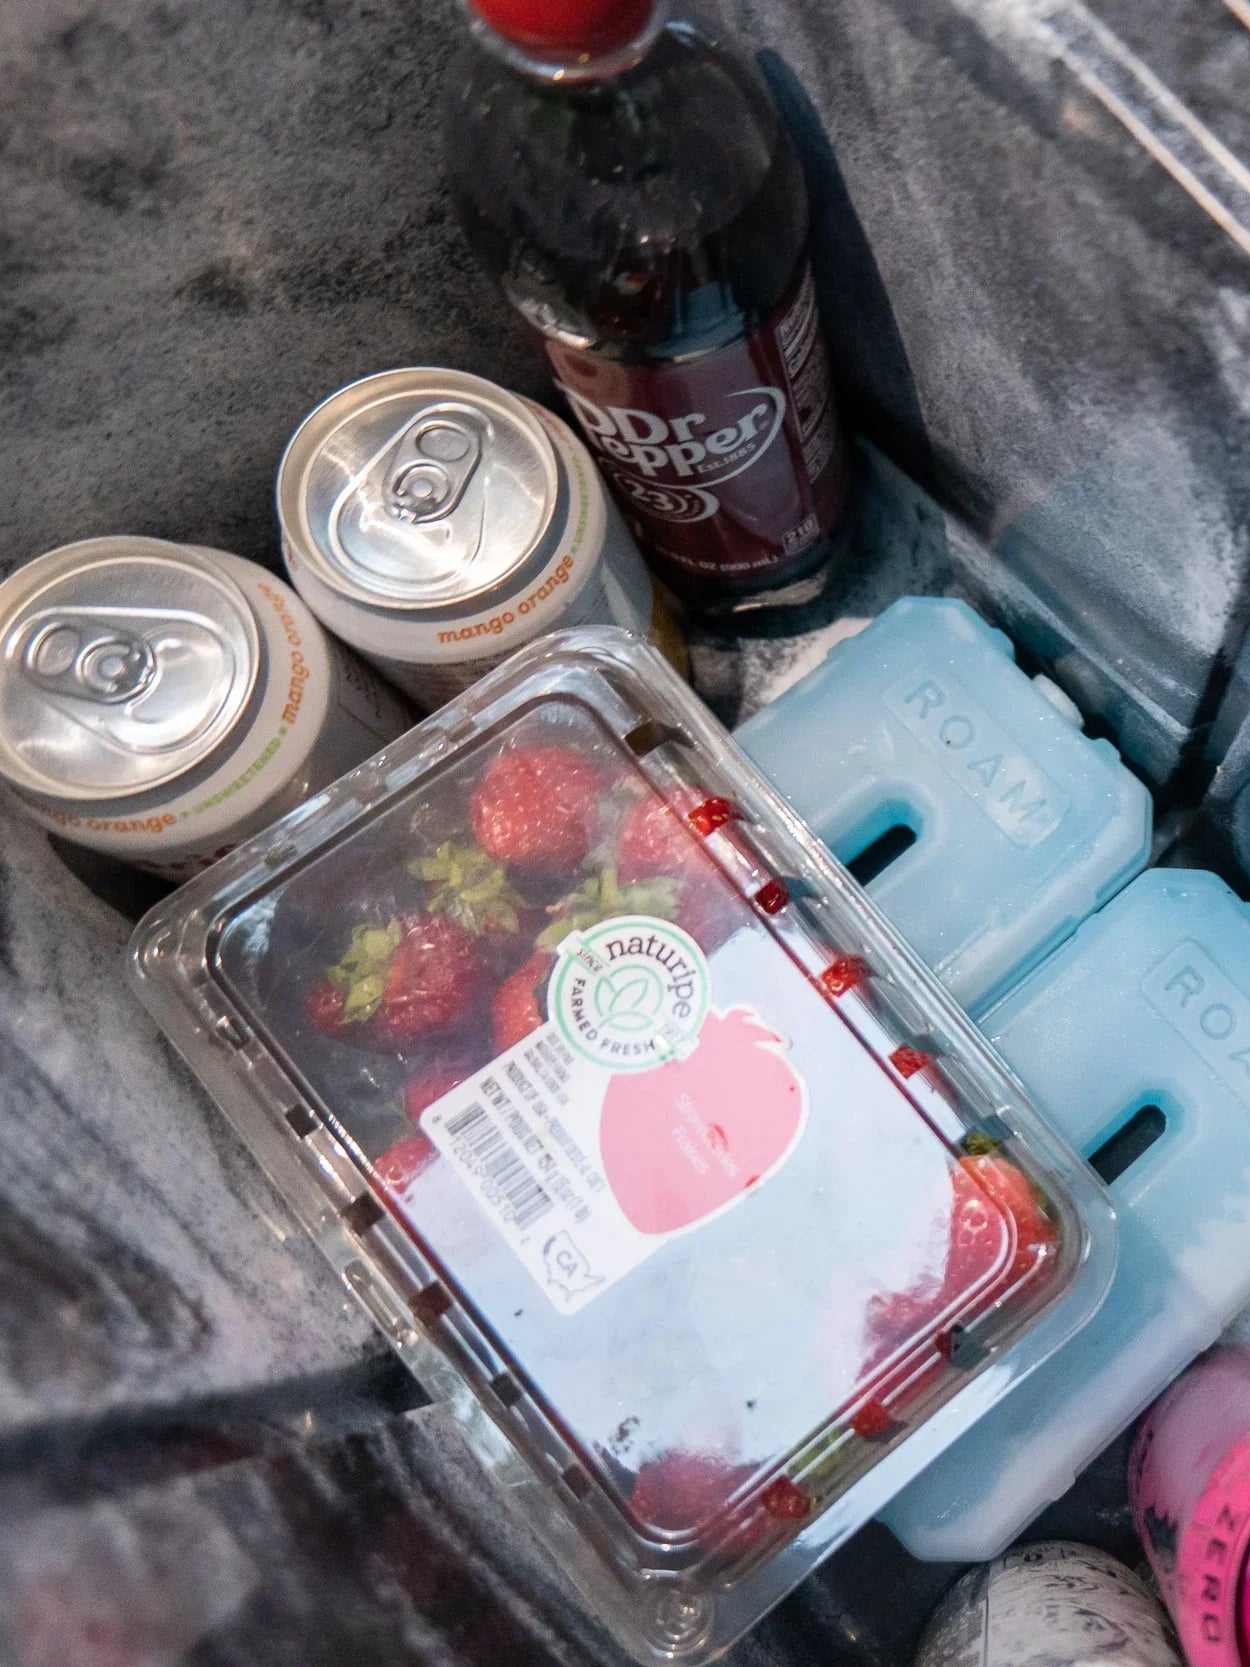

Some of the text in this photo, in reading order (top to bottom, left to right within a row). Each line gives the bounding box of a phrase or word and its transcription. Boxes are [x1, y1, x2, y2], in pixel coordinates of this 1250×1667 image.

[562, 384, 768, 478] Pepper
[610, 406, 706, 444] Dr
[624, 478, 674, 511] 23
[256, 582, 304, 647] orange
[437, 553, 575, 644] mango orange
[281, 648, 312, 725] mango
[904, 678, 1056, 826] ROAM
[86, 811, 178, 834] orange
[576, 946, 604, 974] since
[605, 933, 696, 1020] naturipe
[570, 977, 599, 1042] FARMED
[599, 1036, 657, 1056] FRESH
[478, 1074, 502, 1099] NET
[555, 1249, 580, 1279] CA
[1199, 1502, 1238, 1645] ZERO
